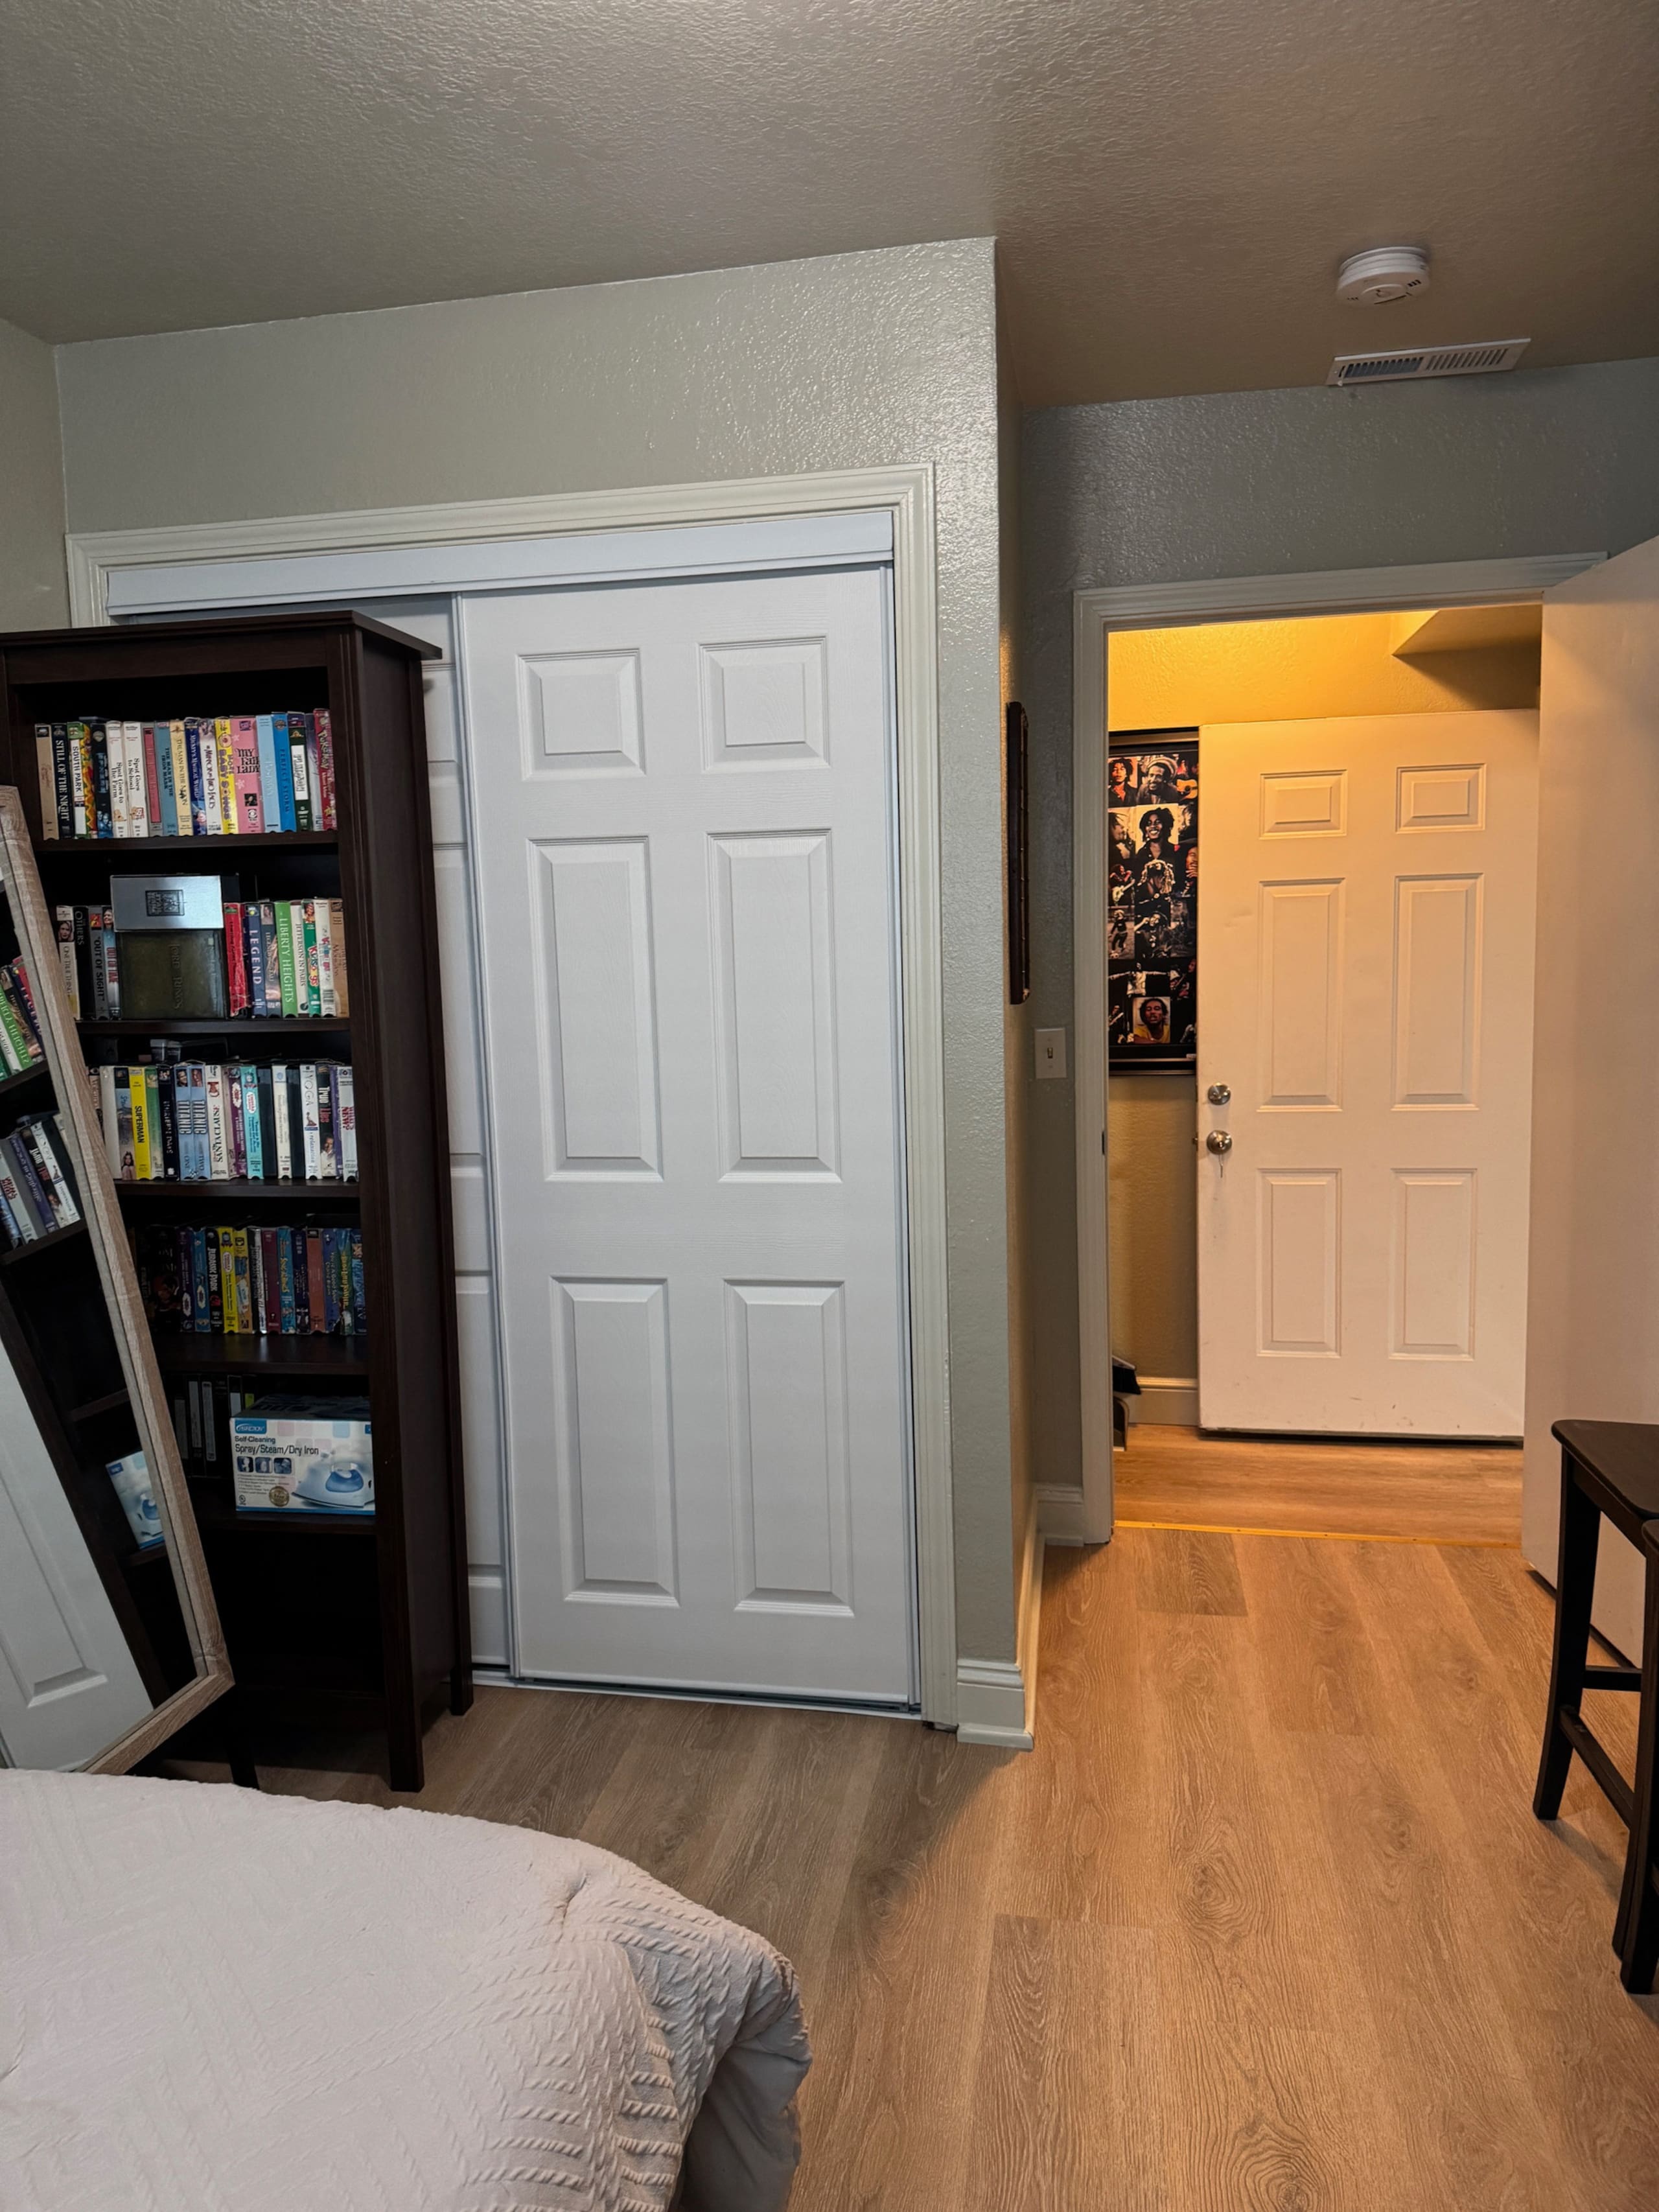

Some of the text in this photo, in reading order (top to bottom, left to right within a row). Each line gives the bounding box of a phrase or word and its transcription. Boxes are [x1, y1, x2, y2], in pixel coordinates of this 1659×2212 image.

[55, 740, 69, 821] STILL OF THE NIGHT
[219, 749, 227, 778] BABY
[279, 749, 288, 782] PERFECT
[107, 947, 117, 959] OUT
[249, 929, 262, 985] LEGEND
[295, 924, 304, 959] JEFFERSON
[95, 959, 102, 970] OF
[279, 918, 294, 1003] LIBERTY HEIGHTS
[304, 1075, 314, 1106] YOGA
[318, 1086, 331, 1123] True Lies
[134, 1105, 145, 1143] SUPERMAN
[177, 1100, 192, 1135] TITANIC
[192, 1100, 207, 1135] TITANIC
[215, 1136, 224, 1163] SANTA
[207, 1247, 218, 1292] JURASSIC PARK
[235, 1436, 276, 1444] Self-Cleaning
[235, 1444, 319, 1455] Spray/Steam/Dry Iron
